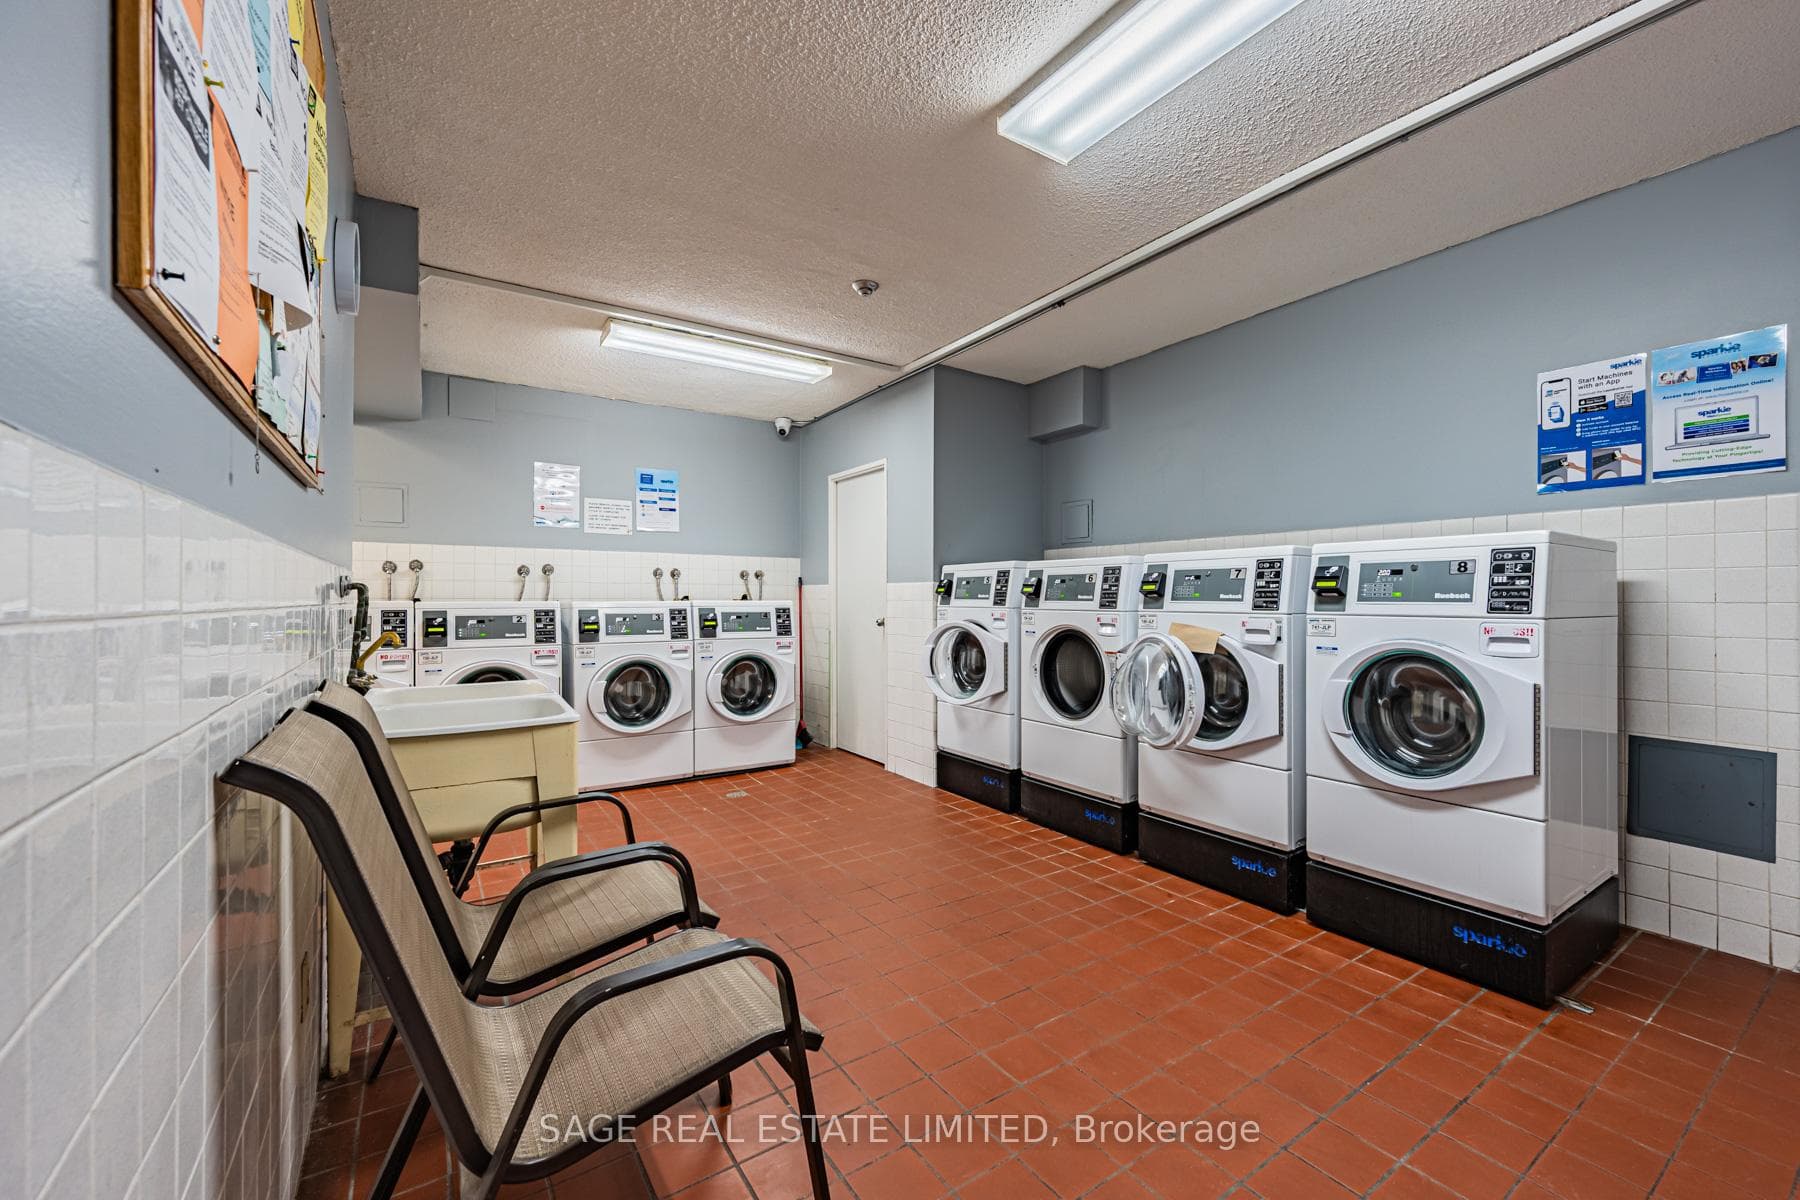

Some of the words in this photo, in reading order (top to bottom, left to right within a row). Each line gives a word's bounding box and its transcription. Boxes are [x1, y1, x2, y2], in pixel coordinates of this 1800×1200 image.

[1578, 377, 1595, 385] Start
[1597, 370, 1633, 381] Machines
[1457, 561, 1468, 573] 8
[1088, 574, 1094, 582] 6
[1234, 570, 1242, 578] 7
